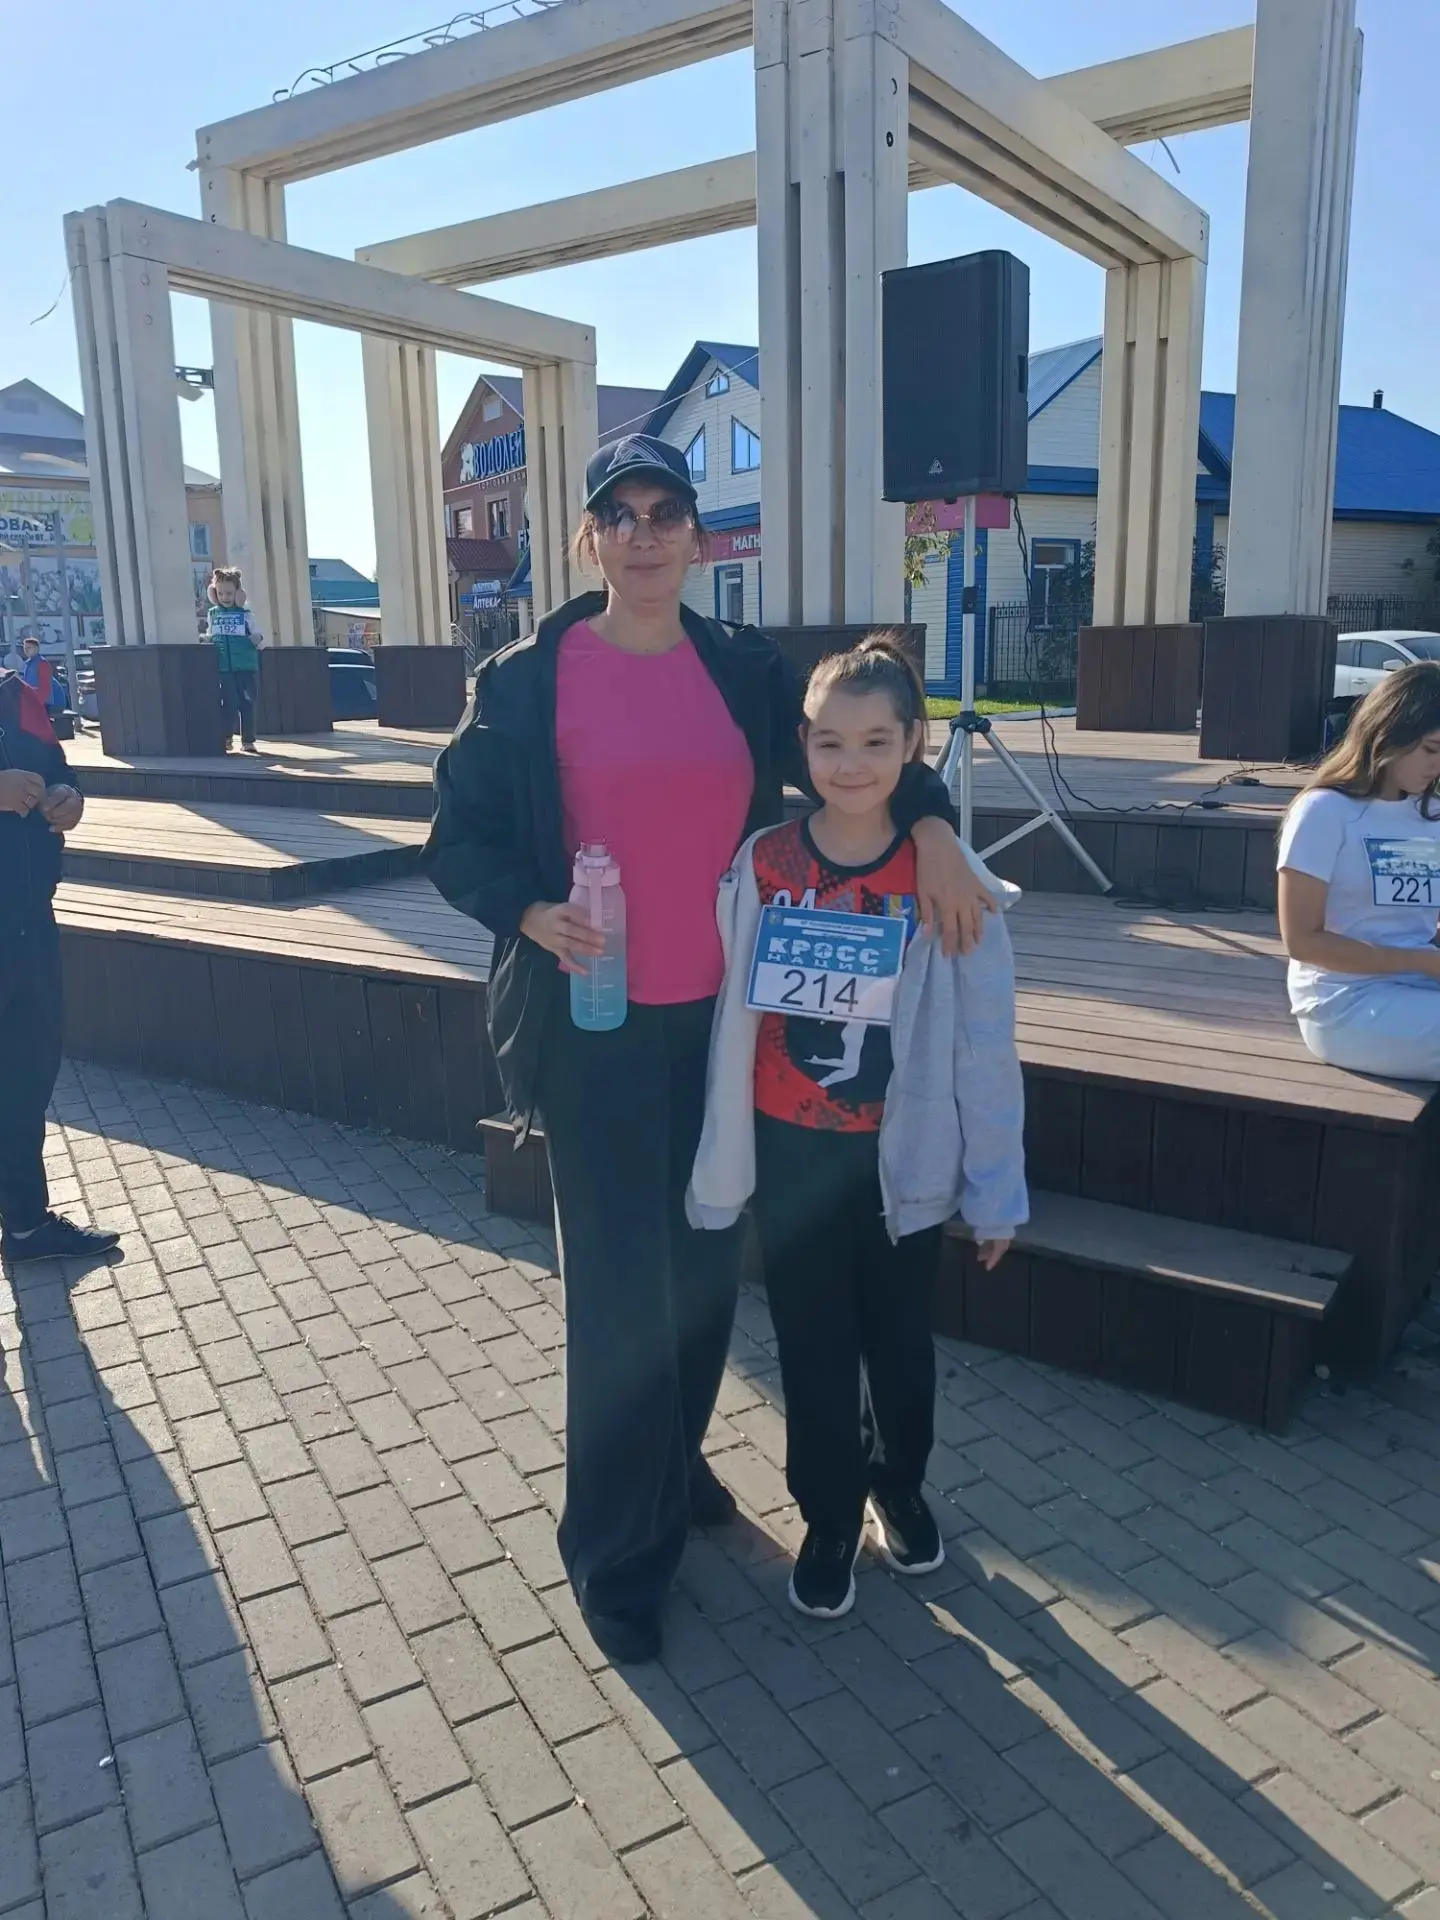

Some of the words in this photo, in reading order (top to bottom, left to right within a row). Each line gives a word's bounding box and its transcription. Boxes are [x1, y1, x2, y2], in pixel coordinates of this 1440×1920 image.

[473, 424, 525, 480] ВОДОЛЕЙ
[219, 625, 237, 634] 192
[1391, 877, 1431, 903] 221
[767, 953, 878, 974] НАЦИИ
[769, 937, 880, 965] КРОСС
[780, 969, 858, 1012] 214
